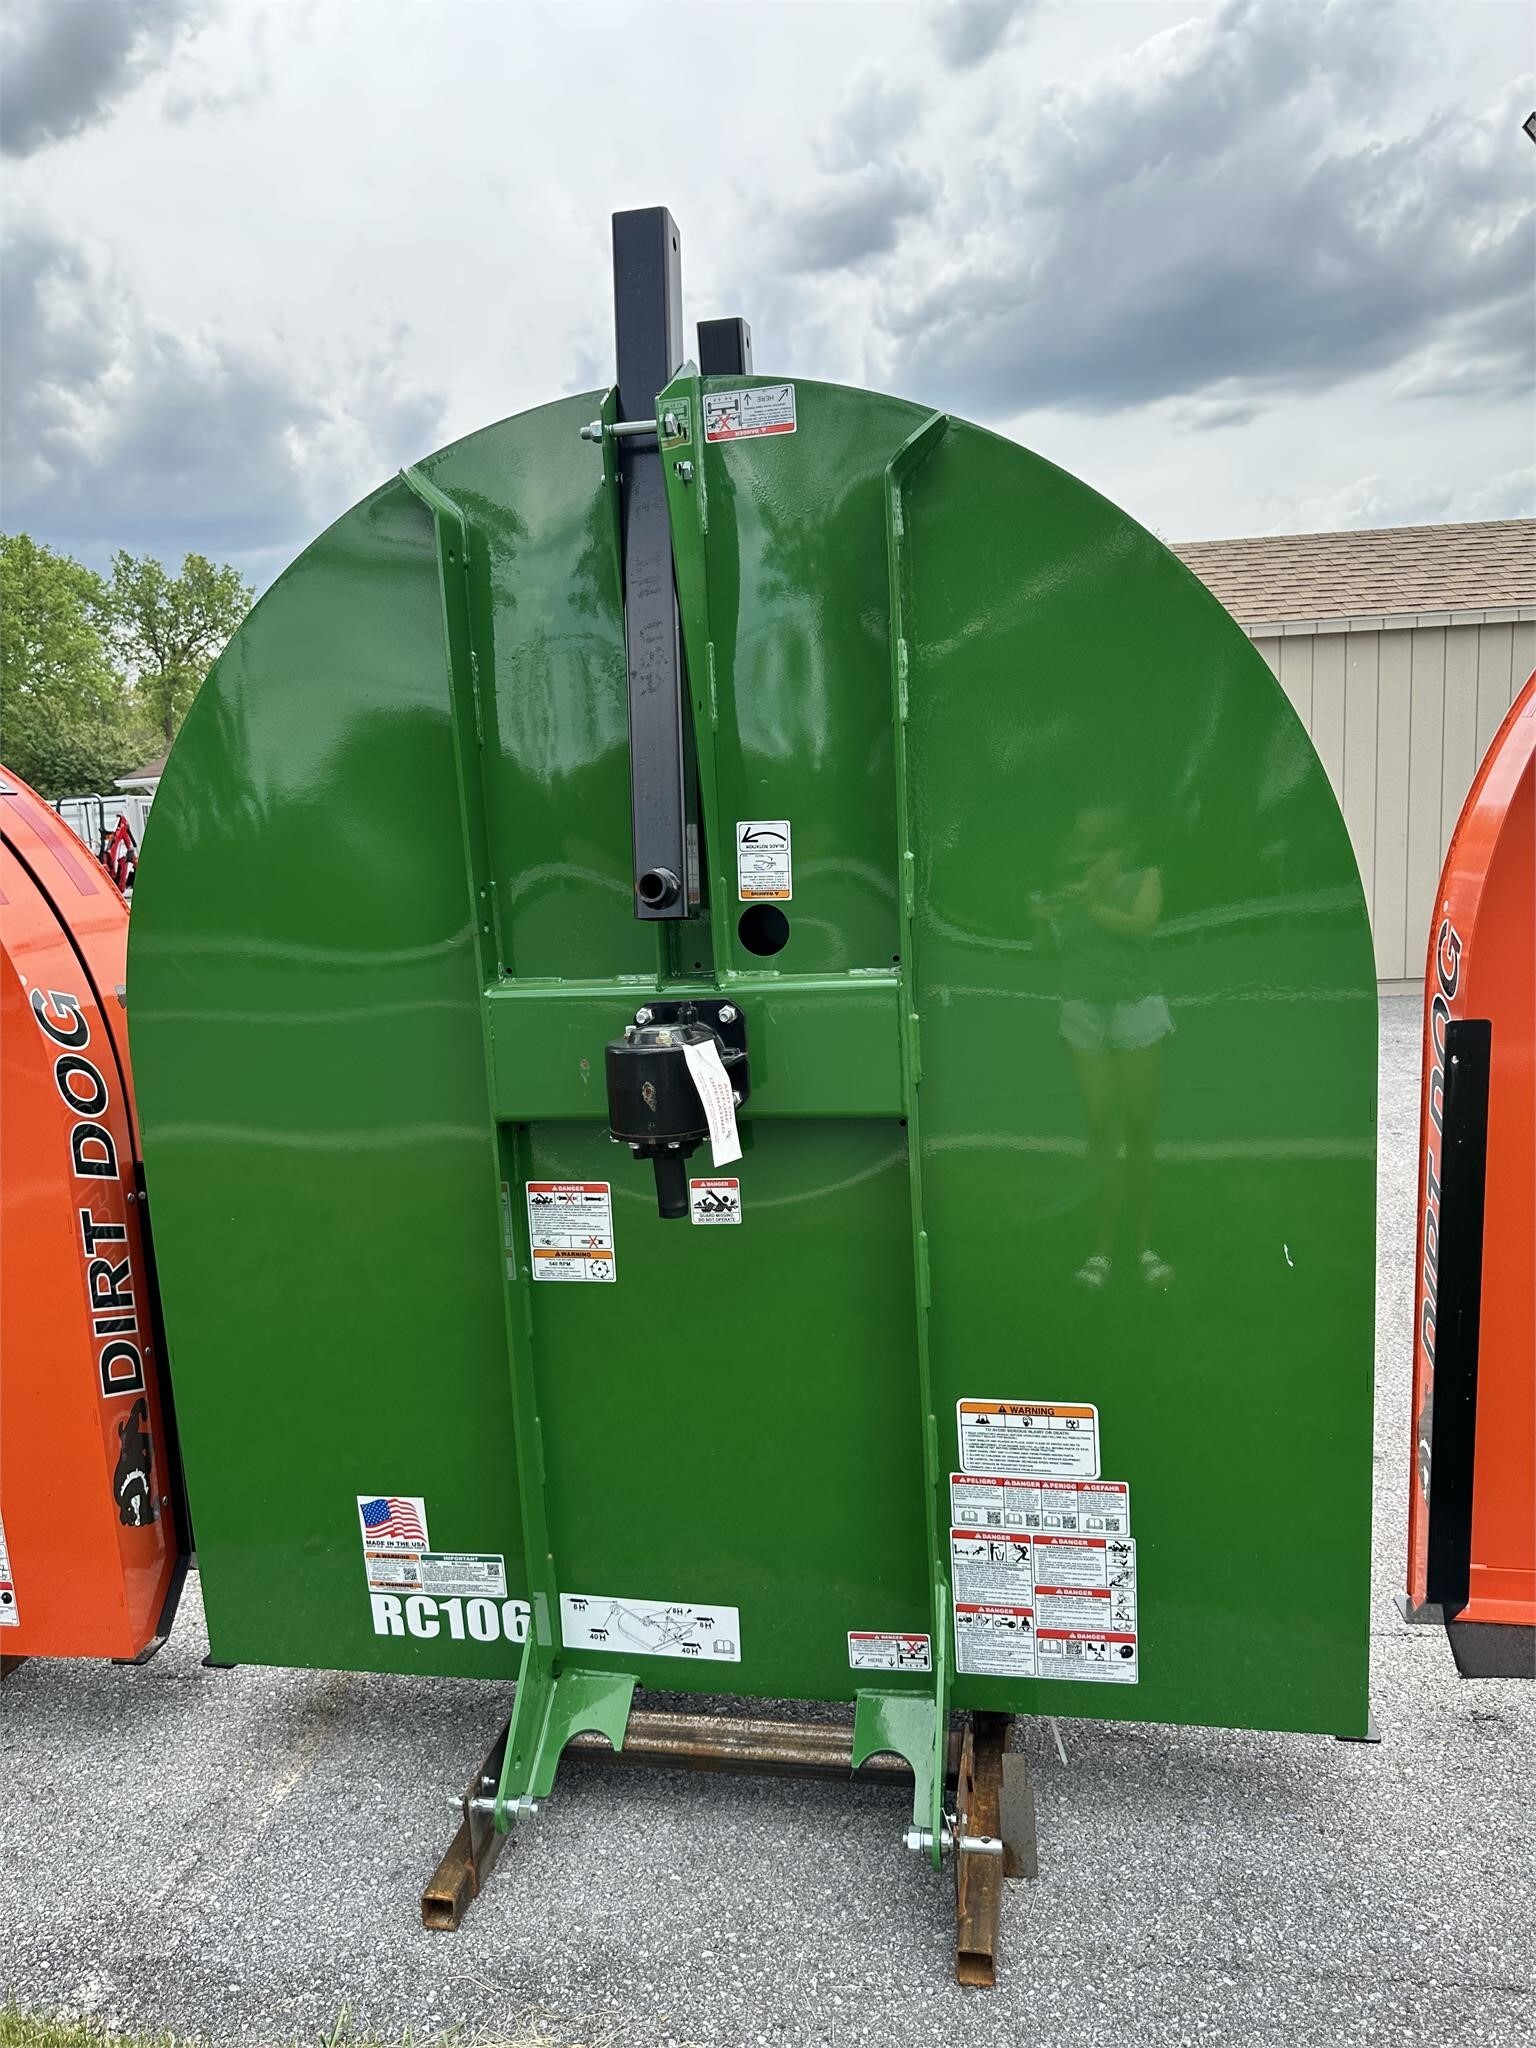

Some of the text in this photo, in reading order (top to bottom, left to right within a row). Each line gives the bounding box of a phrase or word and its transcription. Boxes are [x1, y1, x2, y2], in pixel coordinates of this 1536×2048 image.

[30, 988, 146, 1398] DIRT DOG
[1009, 1406, 1055, 1416] WARNING
[966, 1477, 997, 1485] PELIGRO
[1011, 1480, 1040, 1488] DANGER
[982, 1533, 1011, 1541] DANGER
[1058, 1538, 1088, 1546] DANGER
[370, 1593, 531, 1643] RC106
